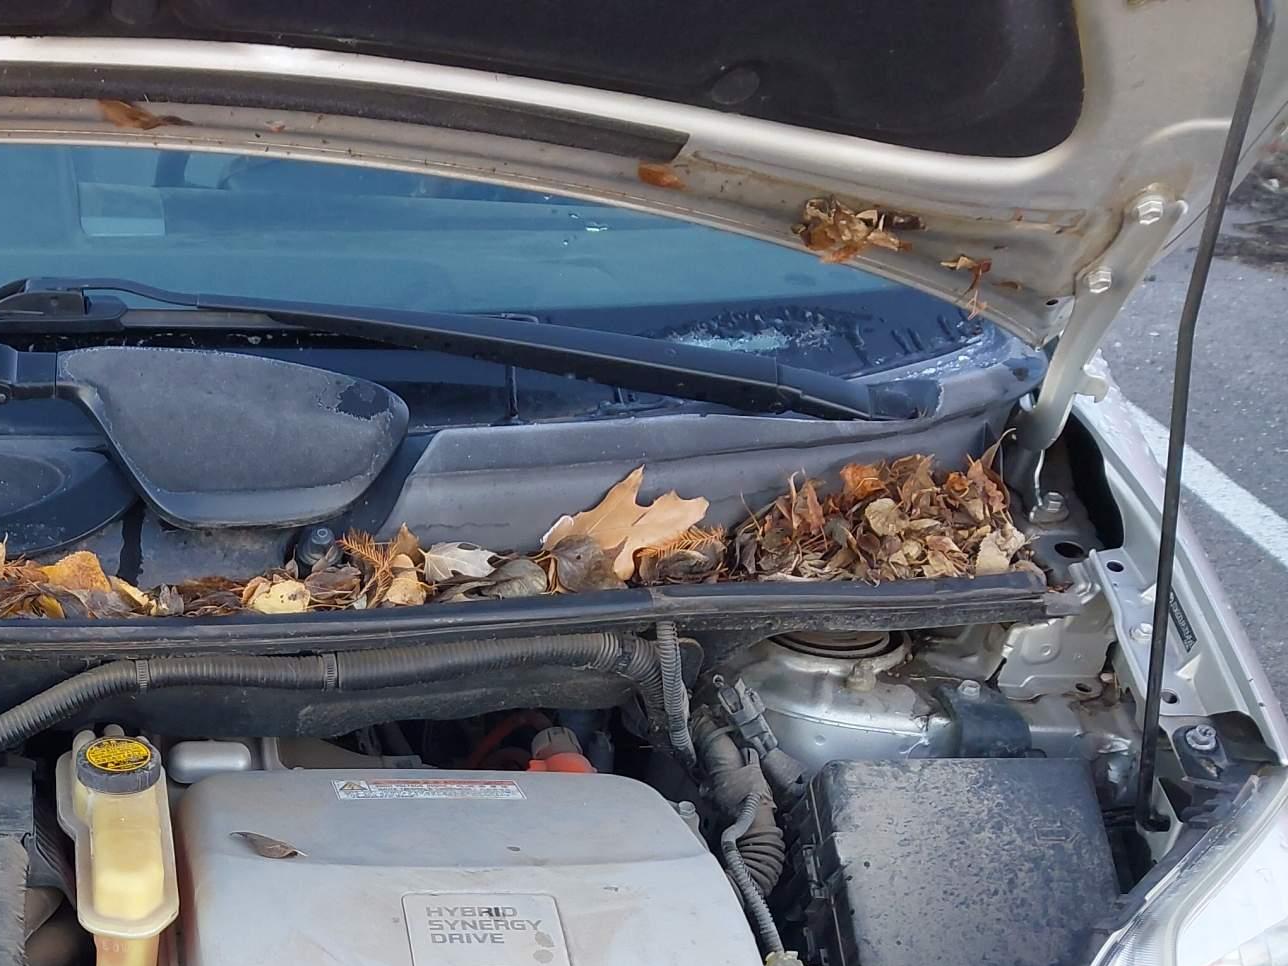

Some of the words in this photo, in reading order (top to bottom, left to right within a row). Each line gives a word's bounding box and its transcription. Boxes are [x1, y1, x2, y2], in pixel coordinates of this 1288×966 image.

[426, 906, 517, 917] HYBRID
[428, 919, 542, 931] SYNERGY
[430, 933, 505, 944] DRIVE
